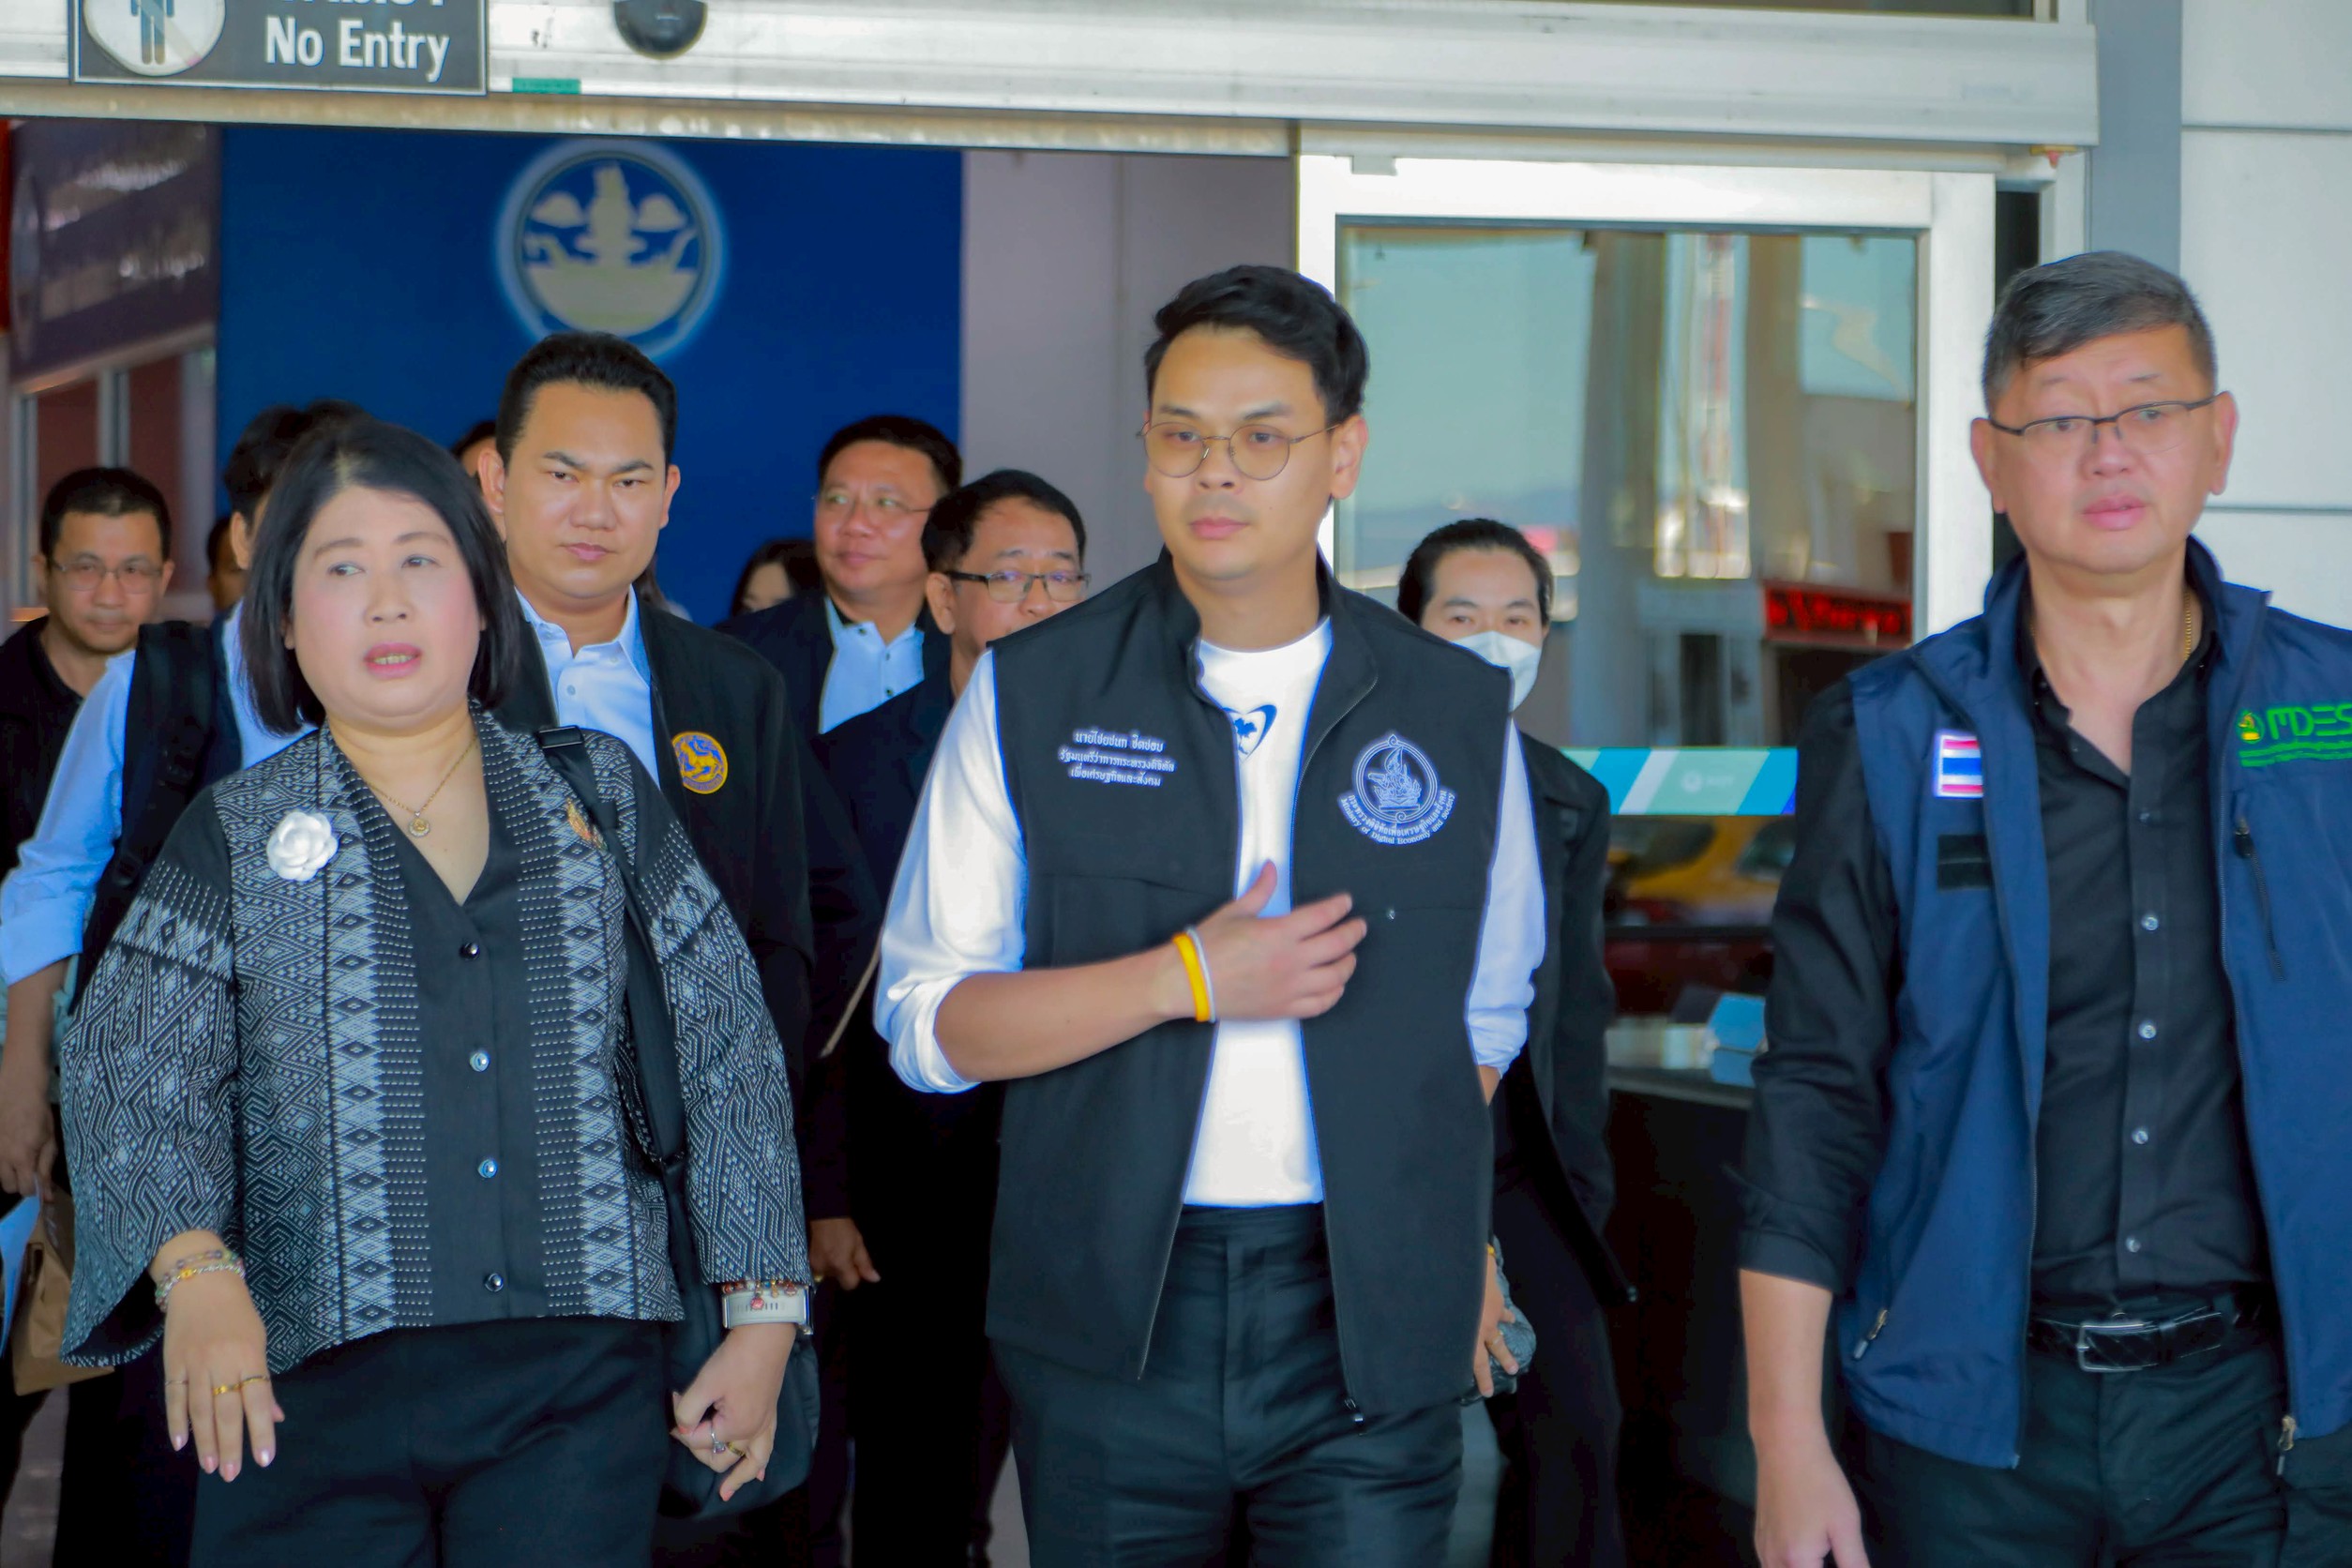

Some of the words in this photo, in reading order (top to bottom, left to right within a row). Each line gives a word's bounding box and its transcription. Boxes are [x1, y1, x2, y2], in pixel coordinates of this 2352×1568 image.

[265, 15, 324, 67] No
[339, 17, 450, 83] Entry
[1397, 830, 1431, 844] Economy
